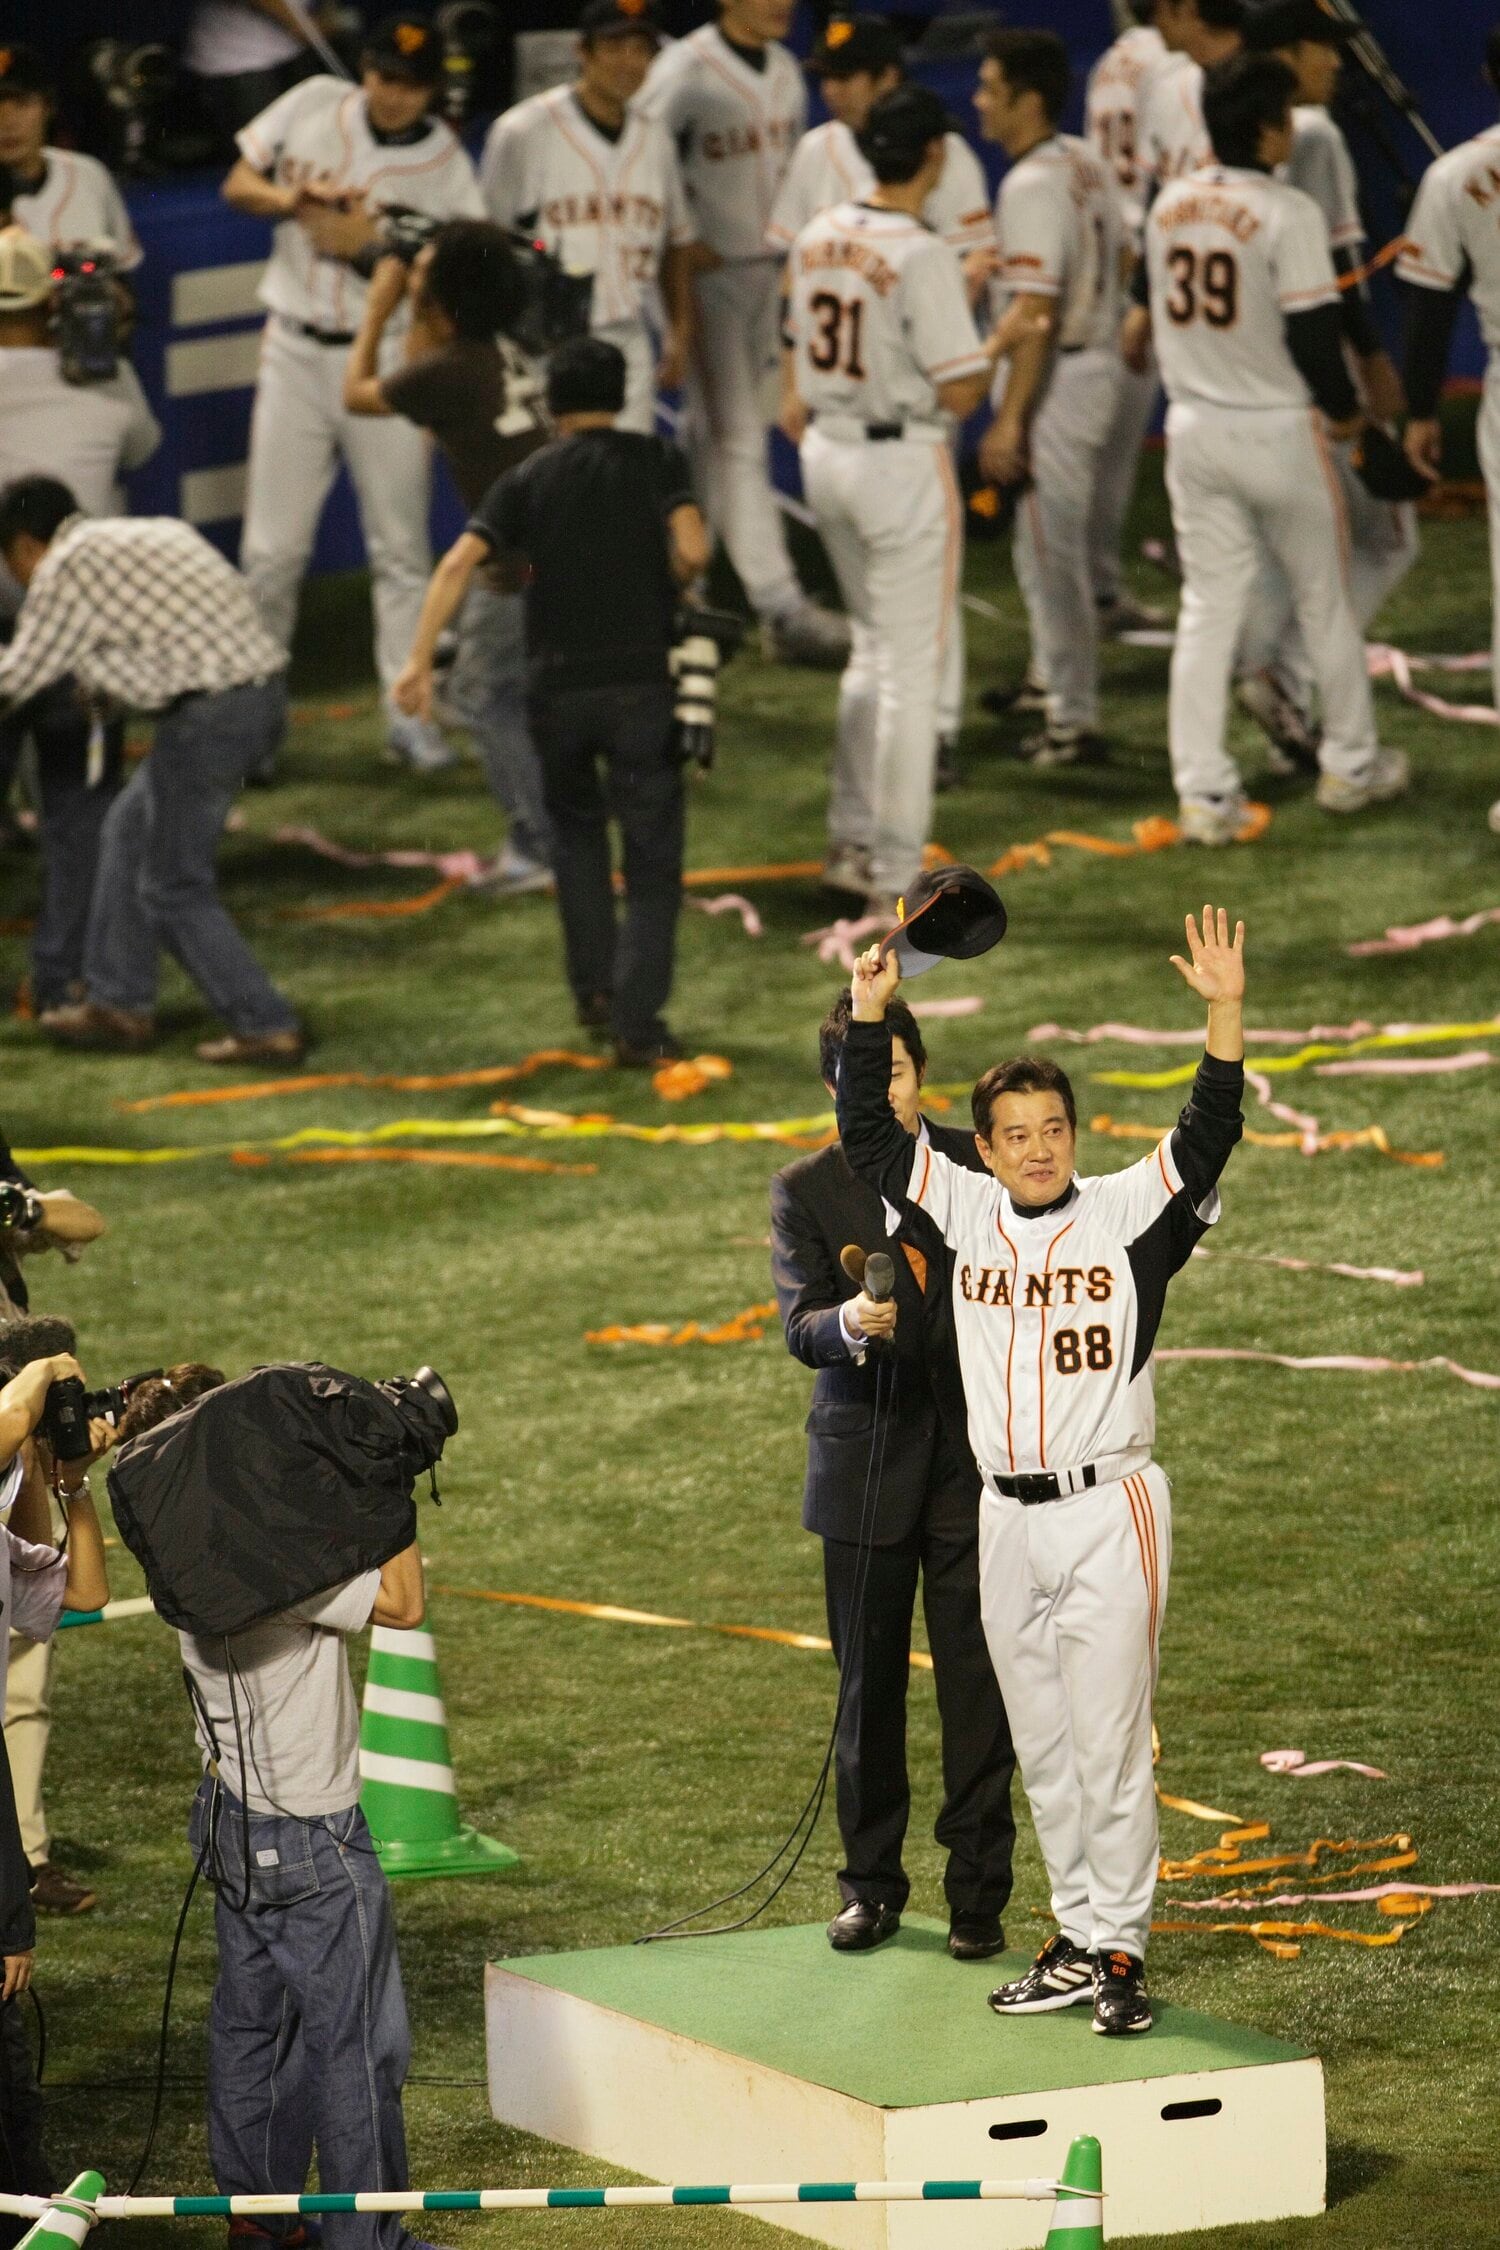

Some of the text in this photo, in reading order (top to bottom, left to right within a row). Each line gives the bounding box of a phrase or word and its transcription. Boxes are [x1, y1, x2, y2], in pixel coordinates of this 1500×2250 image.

[1165, 243, 1237, 329] 39
[808, 290, 867, 381] 31
[960, 1264, 1115, 1308] GIANTS
[1053, 1324, 1114, 1375] 88
[1111, 1964, 1127, 1977] 88
